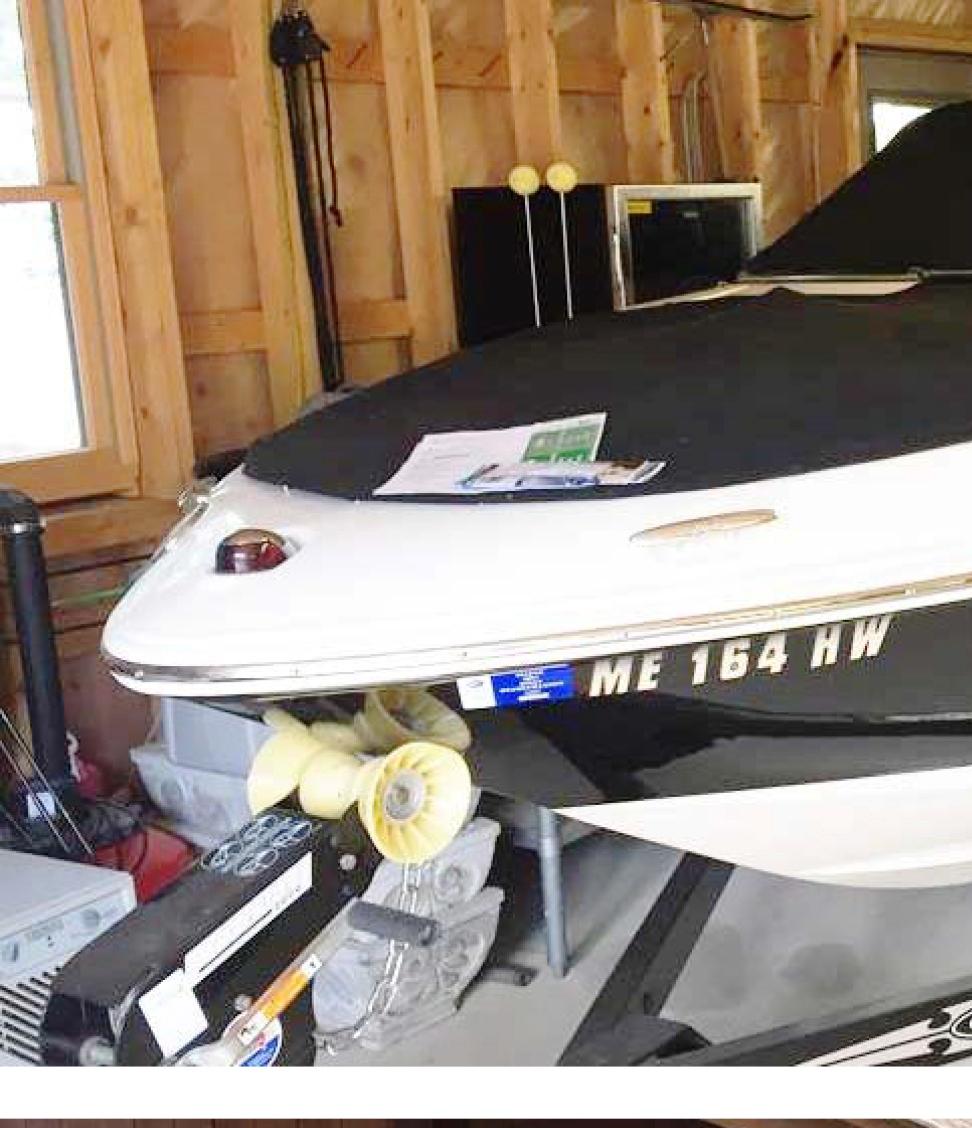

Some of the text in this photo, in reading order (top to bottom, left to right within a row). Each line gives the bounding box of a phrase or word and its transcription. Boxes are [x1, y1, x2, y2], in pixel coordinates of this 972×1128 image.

[588, 651, 664, 697] ME
[691, 631, 790, 686] 164
[809, 613, 895, 669] HW
